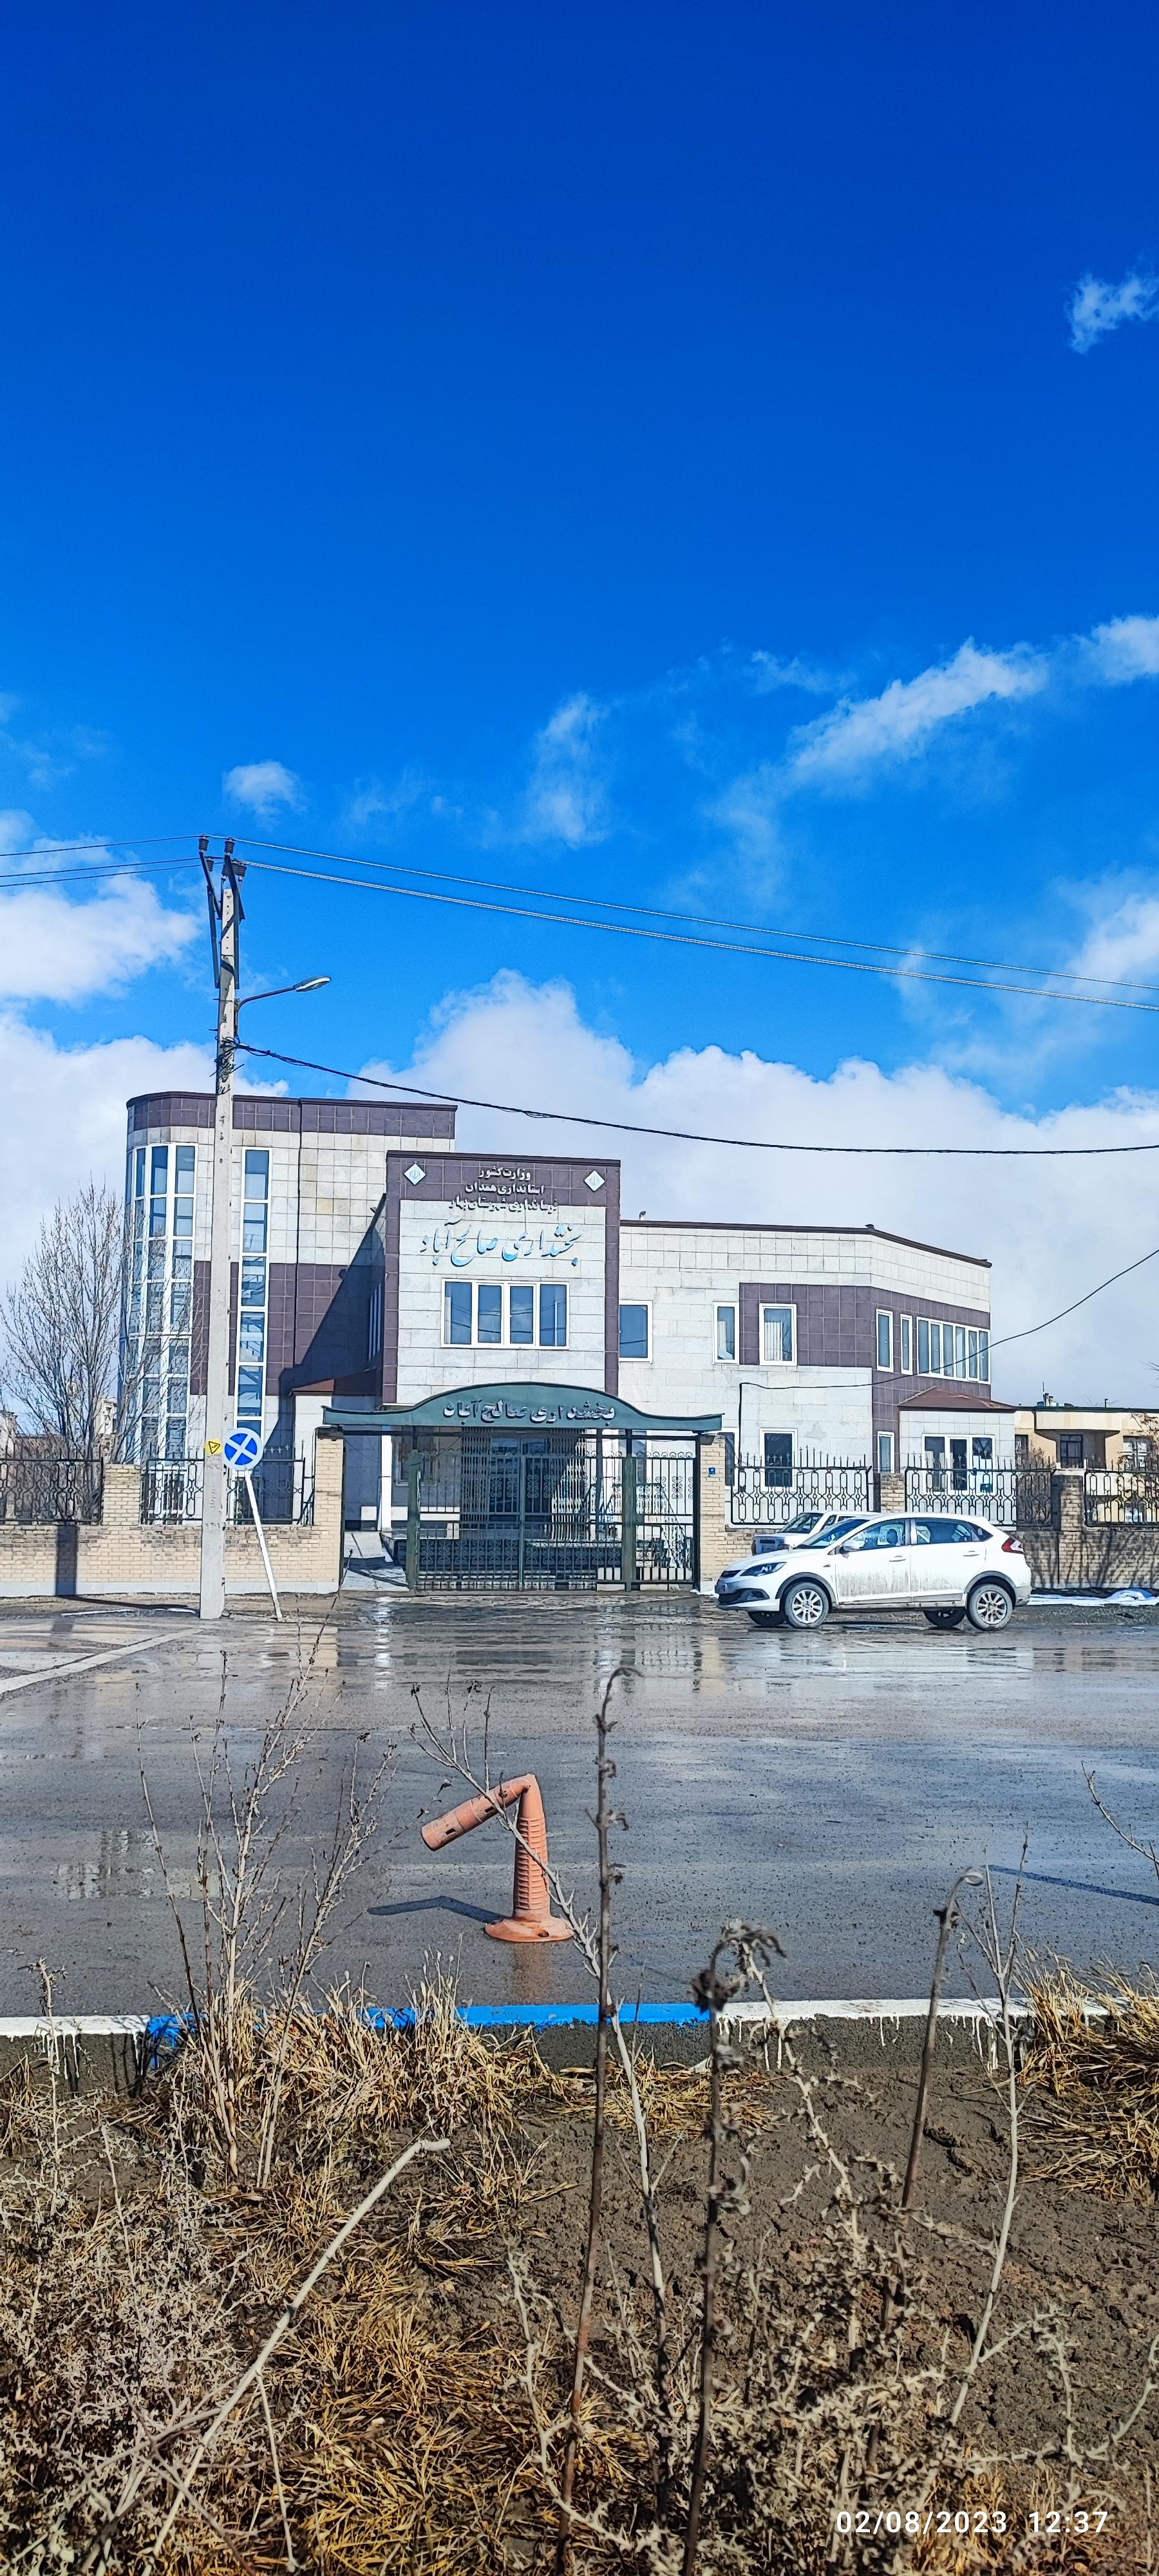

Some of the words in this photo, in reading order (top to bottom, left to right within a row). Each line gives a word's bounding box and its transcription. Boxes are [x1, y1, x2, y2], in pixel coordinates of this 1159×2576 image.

[478, 1165, 504, 1179] کشور
[503, 1168, 531, 1182] وزارت
[465, 1181, 497, 1193] همدان
[498, 1183, 545, 1195] استانداری
[449, 1195, 469, 1211] بهار
[468, 1196, 507, 1212] شهرستان
[507, 1198, 559, 1215] فرمانداری
[420, 1216, 462, 1267] آباد
[450, 1223, 499, 1267] صالح
[501, 1221, 582, 1267] بخشداری
[443, 1396, 482, 1426] آباد
[481, 1399, 529, 1423] صالح
[530, 1400, 616, 1427] بخشداری
